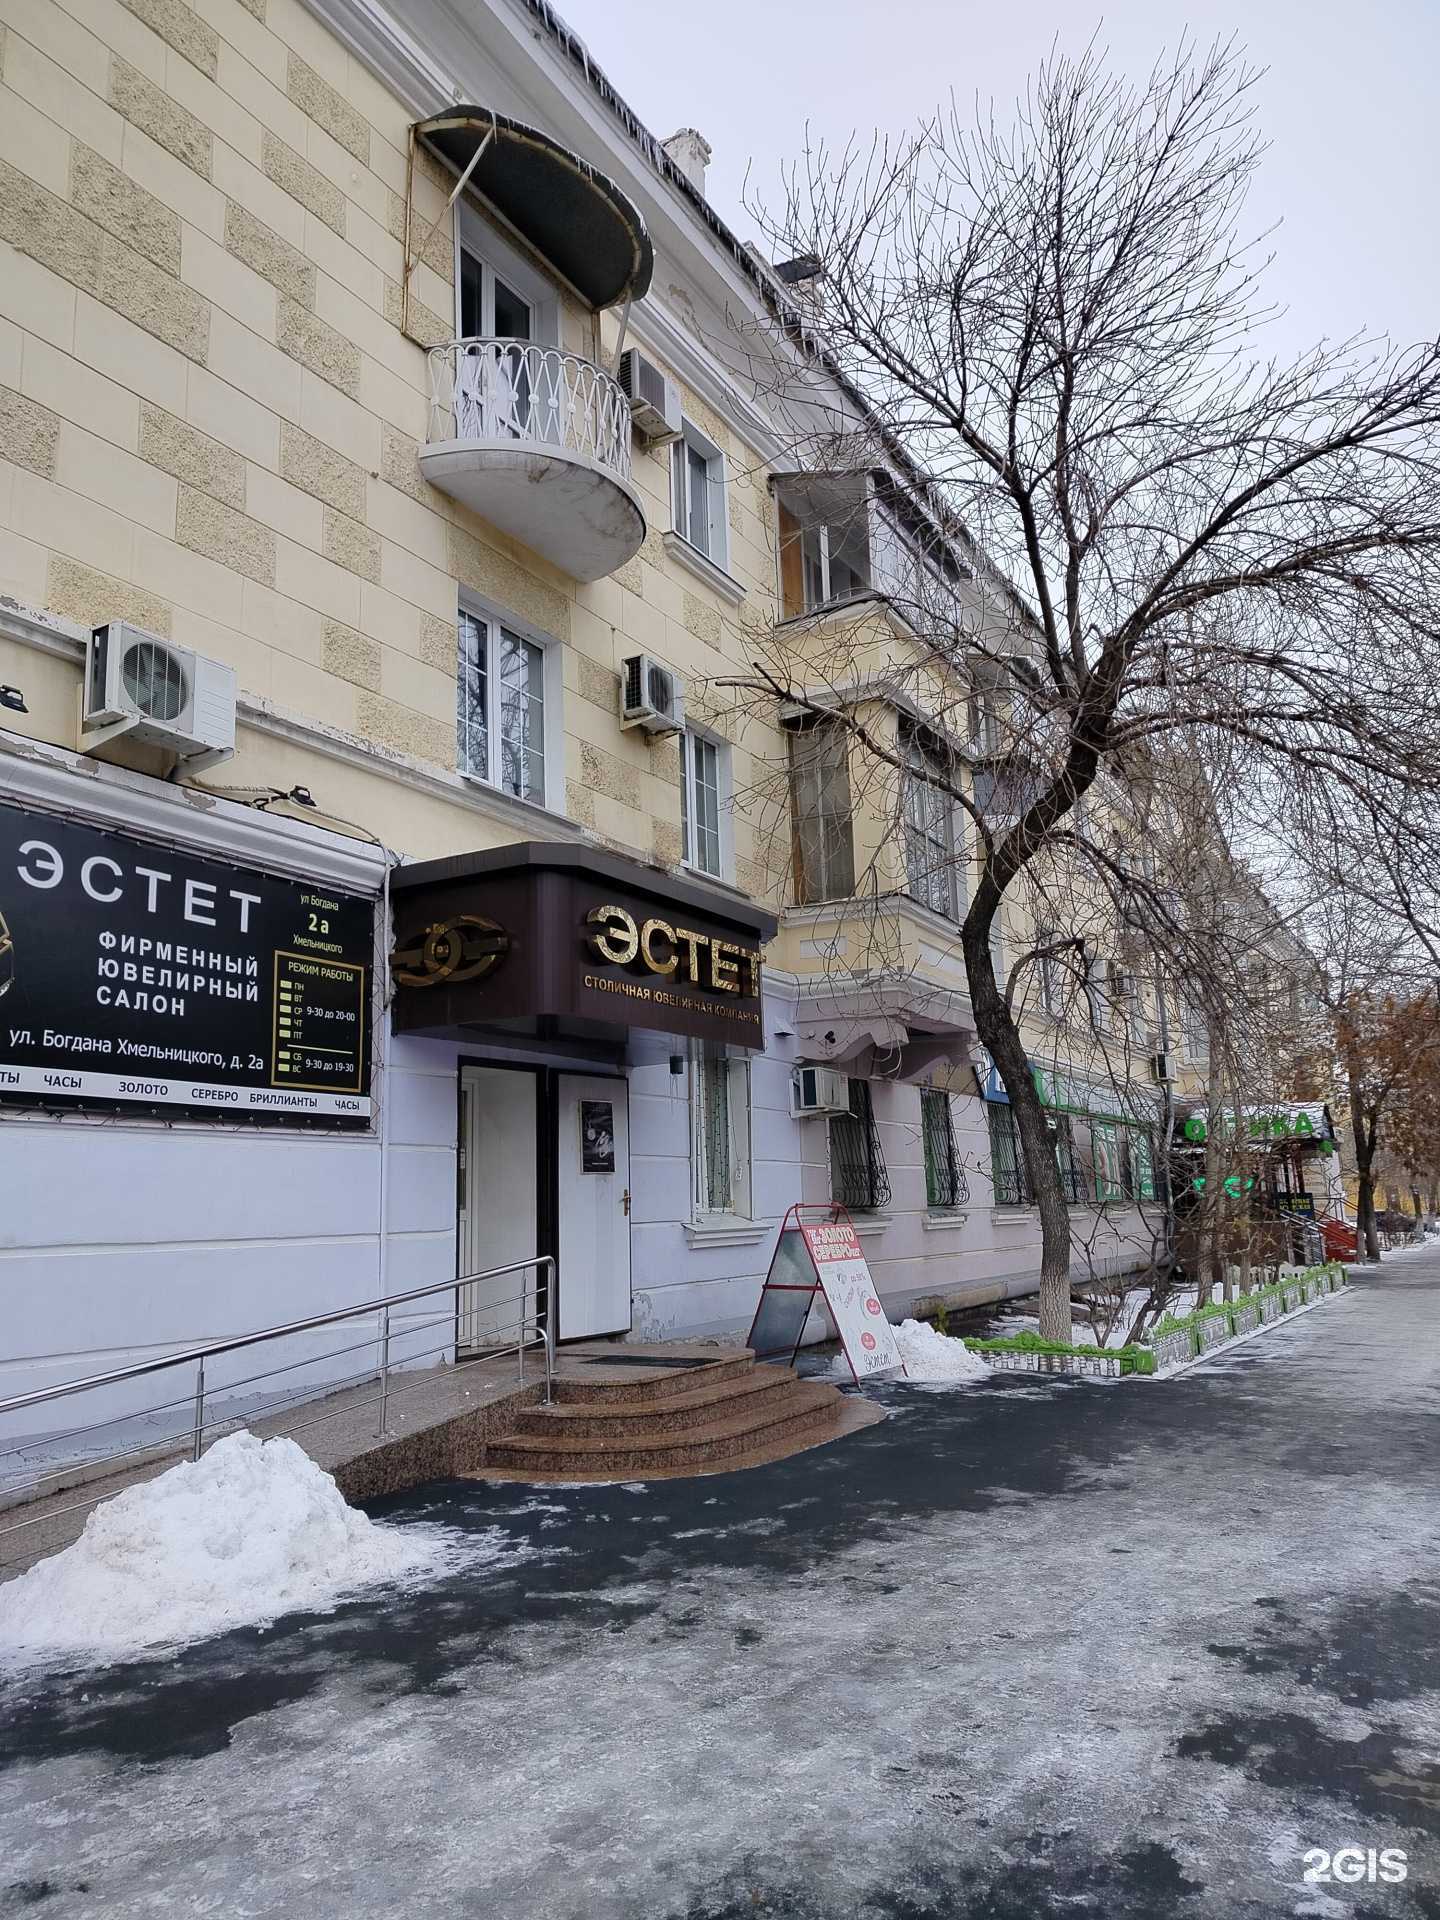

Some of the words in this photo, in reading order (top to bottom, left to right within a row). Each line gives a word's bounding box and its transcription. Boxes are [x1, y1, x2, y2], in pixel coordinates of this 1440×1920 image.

[17, 840, 261, 933] ЭСТЕТ
[310, 895, 339, 911] Богдана
[98, 931, 258, 977] ФИРМЕННЫЙ
[293, 934, 343, 954] Хмельницкого
[587, 905, 767, 997] ЭСТЕТ
[98, 957, 258, 1002] ЮВЕЛИРНЫЙ
[288, 961, 319, 976] РЕЖИМ
[321, 968, 354, 982] РАБОТЫ
[294, 982, 305, 991] ПН
[96, 985, 185, 1016] САЛОН
[293, 994, 303, 1003] ВТ
[584, 975, 650, 1000] СТОЛИЧНАЯ
[653, 990, 713, 1013] ЮВЕЛИРНАЯ
[714, 1004, 760, 1025] КОМПАНИЯ
[293, 1007, 303, 1015] СР
[306, 1006, 324, 1017] 9-30
[324, 1011, 334, 1019] до
[335, 1010, 355, 1022] 20-00
[293, 1019, 303, 1027] ЧТ
[293, 1031, 303, 1039] ПТ
[9, 1029, 36, 1047] ул.
[43, 1029, 112, 1053] Богдана
[117, 1038, 226, 1069] Хмельницкого,
[230, 1055, 243, 1070] д.
[248, 1054, 264, 1070] 2а
[305, 1059, 322, 1069] 9-30
[323, 1063, 333, 1071] до
[334, 1062, 354, 1073] 19-30
[43, 1074, 82, 1088] ЧАСЫ
[118, 1081, 169, 1096] ЗОЛОТО
[191, 1088, 239, 1102] СЕРЕБРО
[249, 1093, 318, 1108] БРИЛЛИАНТЫ
[334, 1099, 360, 1111] ЧАСЫ
